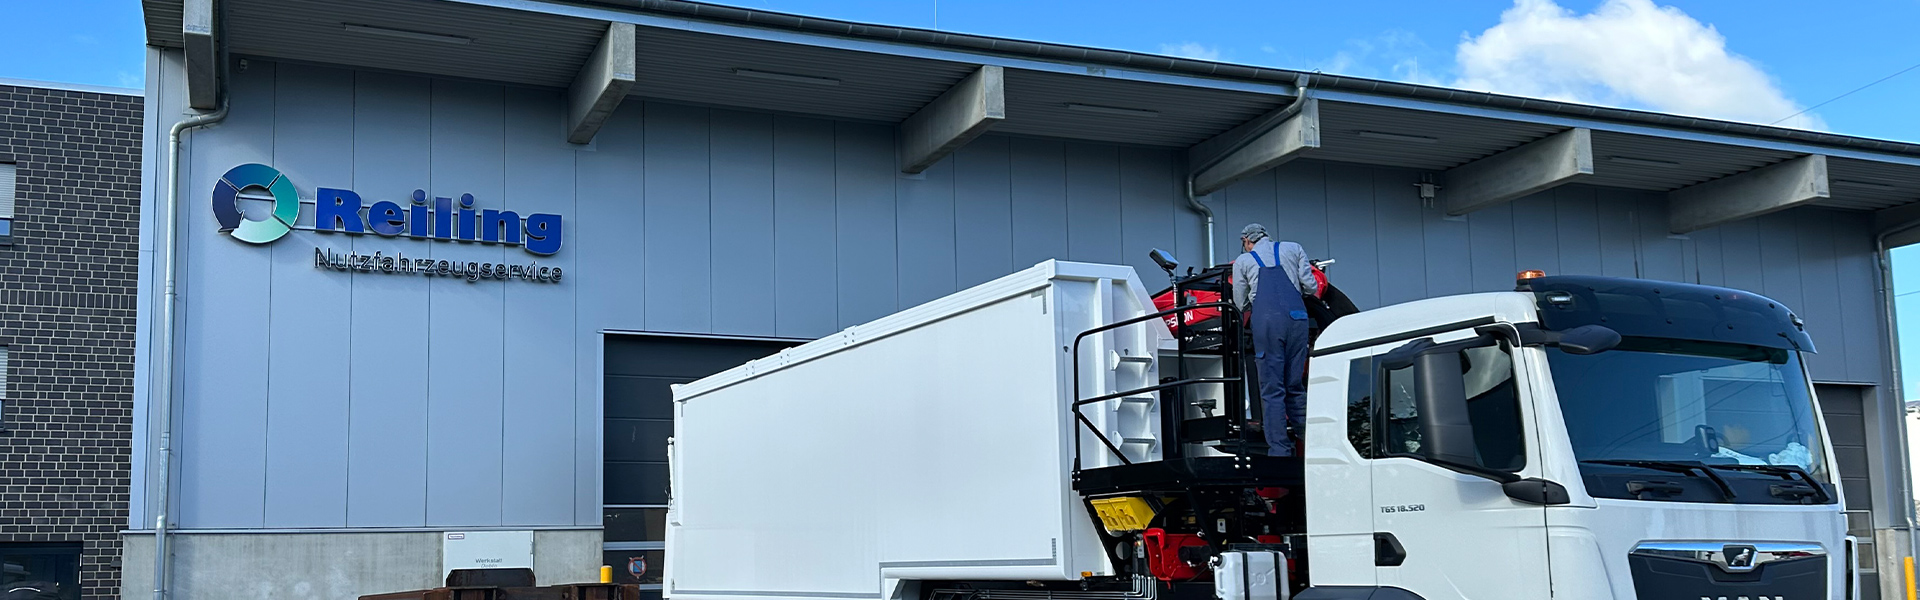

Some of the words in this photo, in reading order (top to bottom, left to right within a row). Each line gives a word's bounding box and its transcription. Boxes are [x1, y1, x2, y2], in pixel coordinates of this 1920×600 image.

[315, 187, 563, 255] Reiling
[313, 247, 563, 282] Nutzfahrzeugservice
[1397, 504, 1425, 512] 18.520
